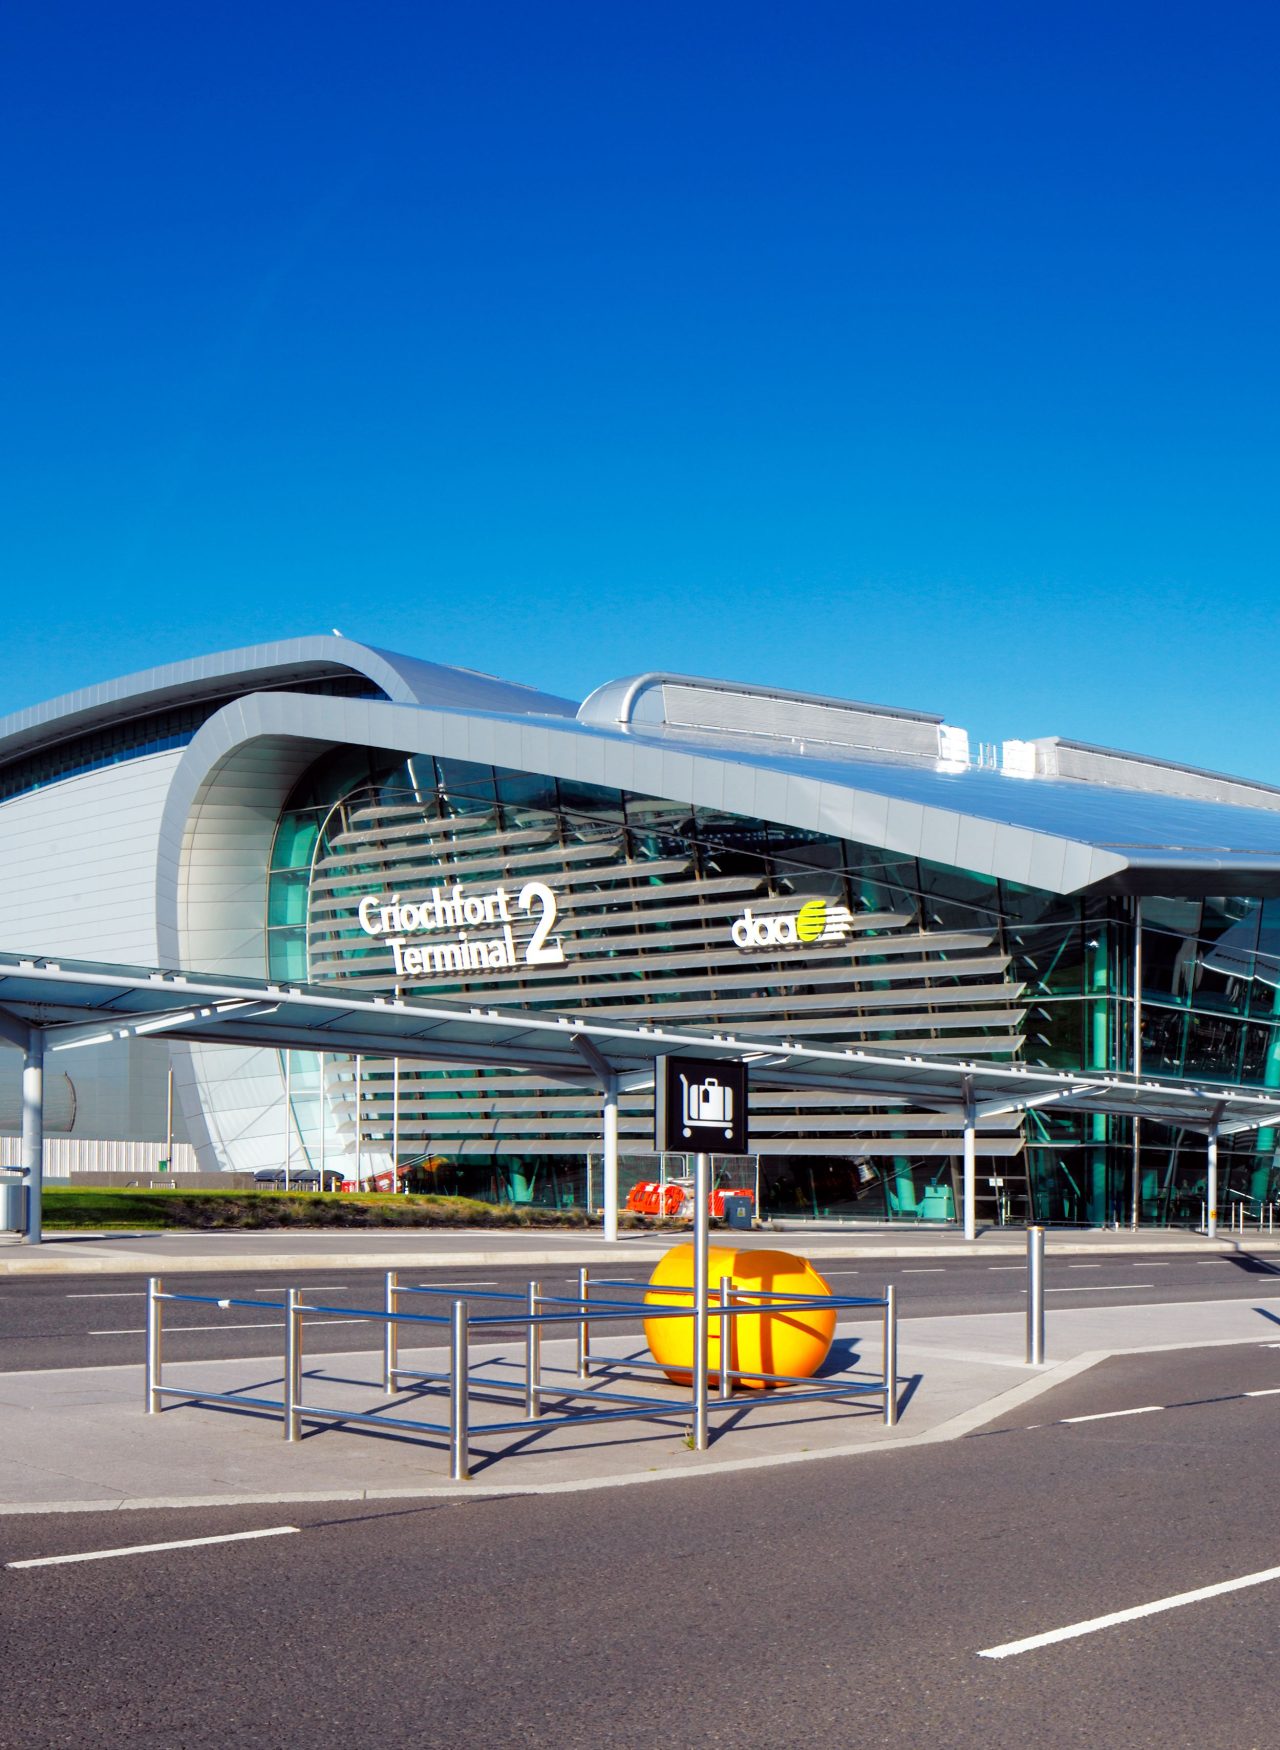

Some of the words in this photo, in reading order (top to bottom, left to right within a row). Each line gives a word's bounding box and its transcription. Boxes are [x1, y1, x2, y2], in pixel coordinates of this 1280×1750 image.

[358, 885, 512, 935] Críochfort
[385, 924, 517, 975] Terminal
[518, 882, 565, 965] 2
[732, 908, 798, 948] daa
